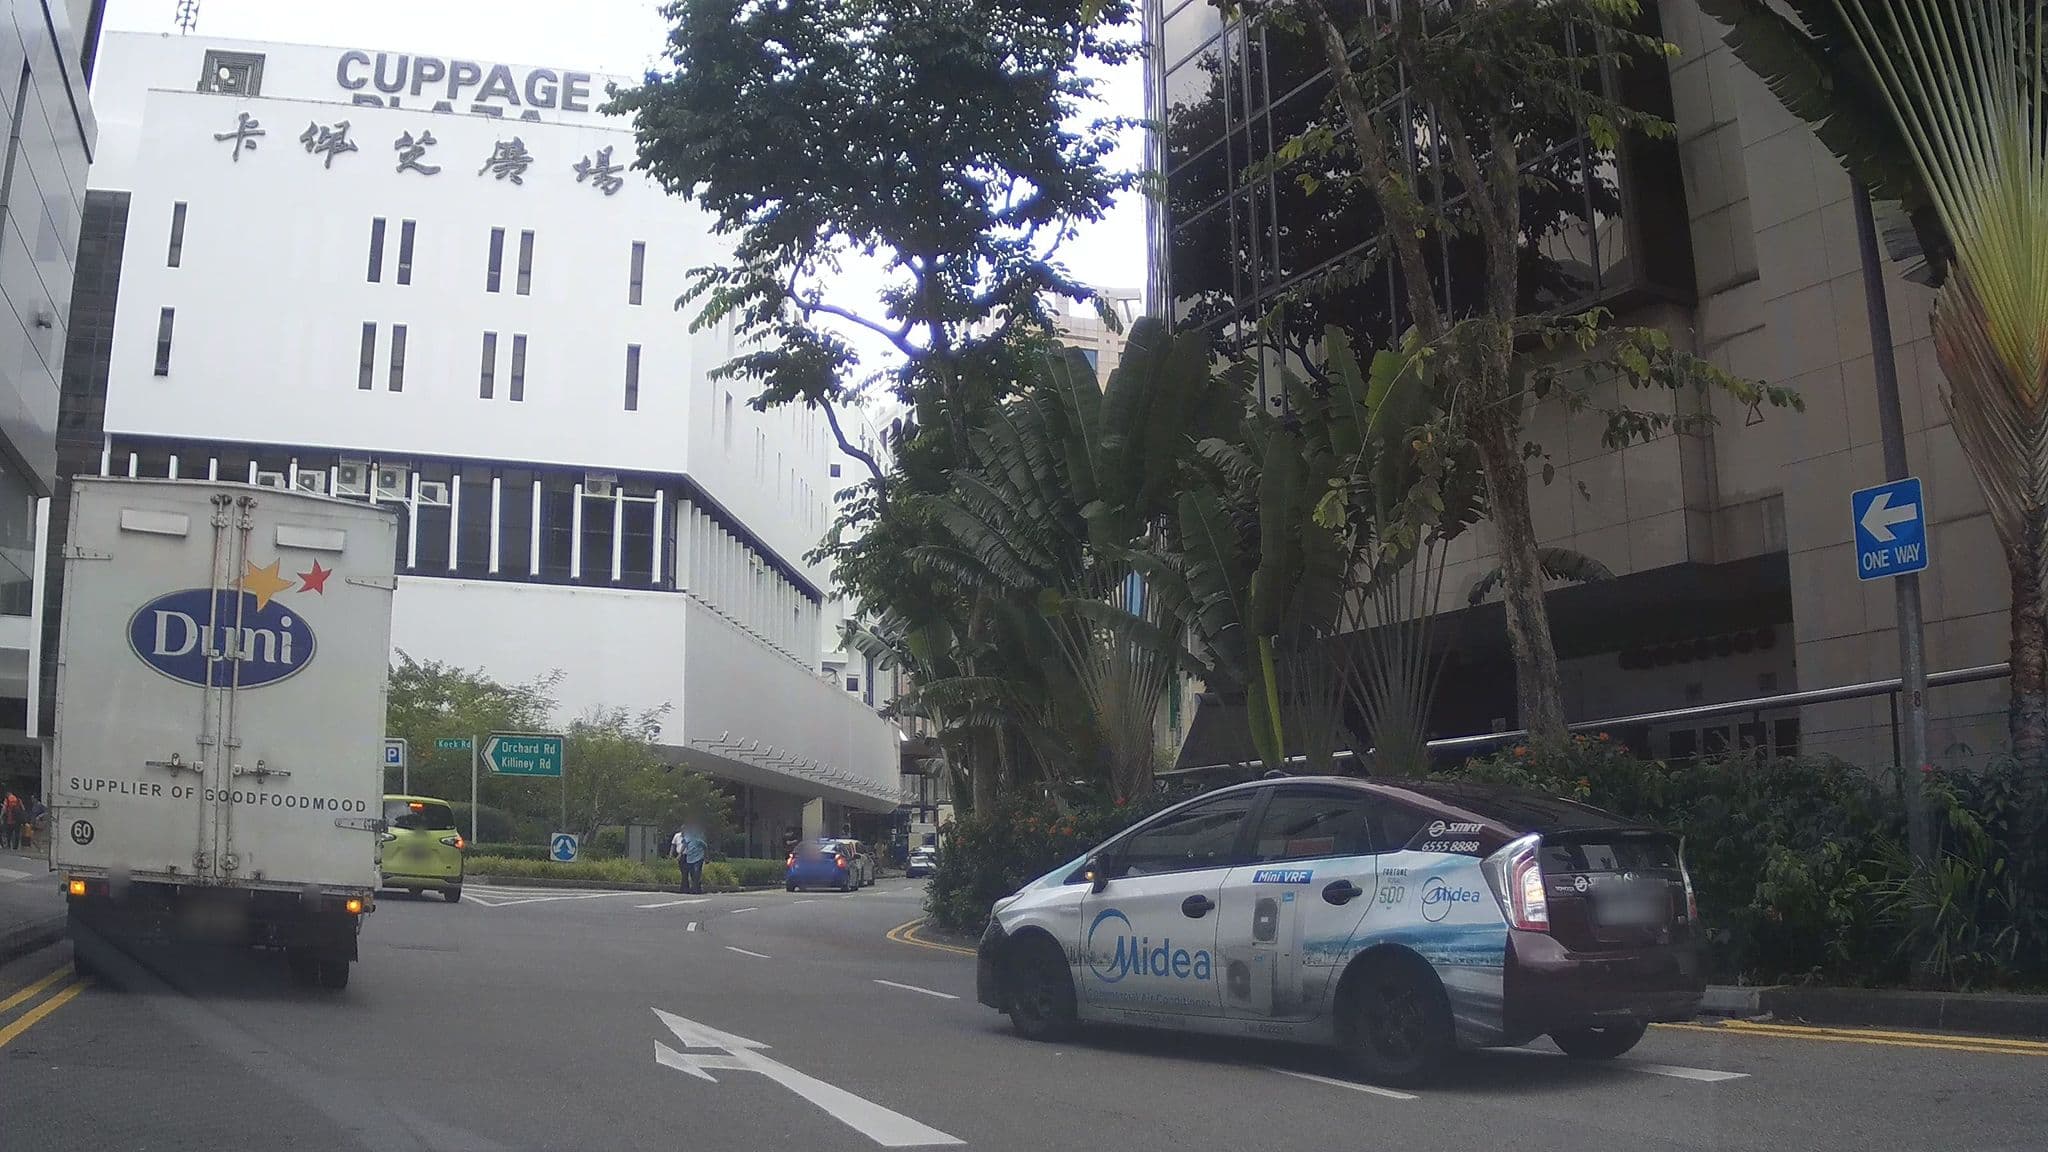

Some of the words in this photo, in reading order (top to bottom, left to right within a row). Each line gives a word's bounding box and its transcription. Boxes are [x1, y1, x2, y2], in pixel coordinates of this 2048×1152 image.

[336, 50, 592, 113] CUPPAGE
[1863, 549, 1889, 571] ONE
[1894, 543, 1920, 564] WAY
[152, 609, 294, 665] Duni
[461, 740, 471, 749] Rd
[501, 741, 539, 755] Orchard
[543, 743, 556, 755] Rd
[387, 748, 398, 762] P
[501, 756, 535, 770] Killiney
[539, 758, 551, 770] Rd
[70, 777, 162, 797] SUPPLIER
[171, 786, 194, 799] OF
[205, 789, 366, 812] GOODFOODMOOD
[74, 822, 91, 838] 60
[1446, 823, 1485, 832] SMRT
[1422, 841, 1449, 851] 6555
[1450, 841, 1479, 852] 8888
[1258, 871, 1282, 882] Mini
[1284, 871, 1308, 882] VRF
[1380, 886, 1405, 904] 500
[1428, 884, 1480, 903] Midea
[1092, 932, 1211, 983] Midea
